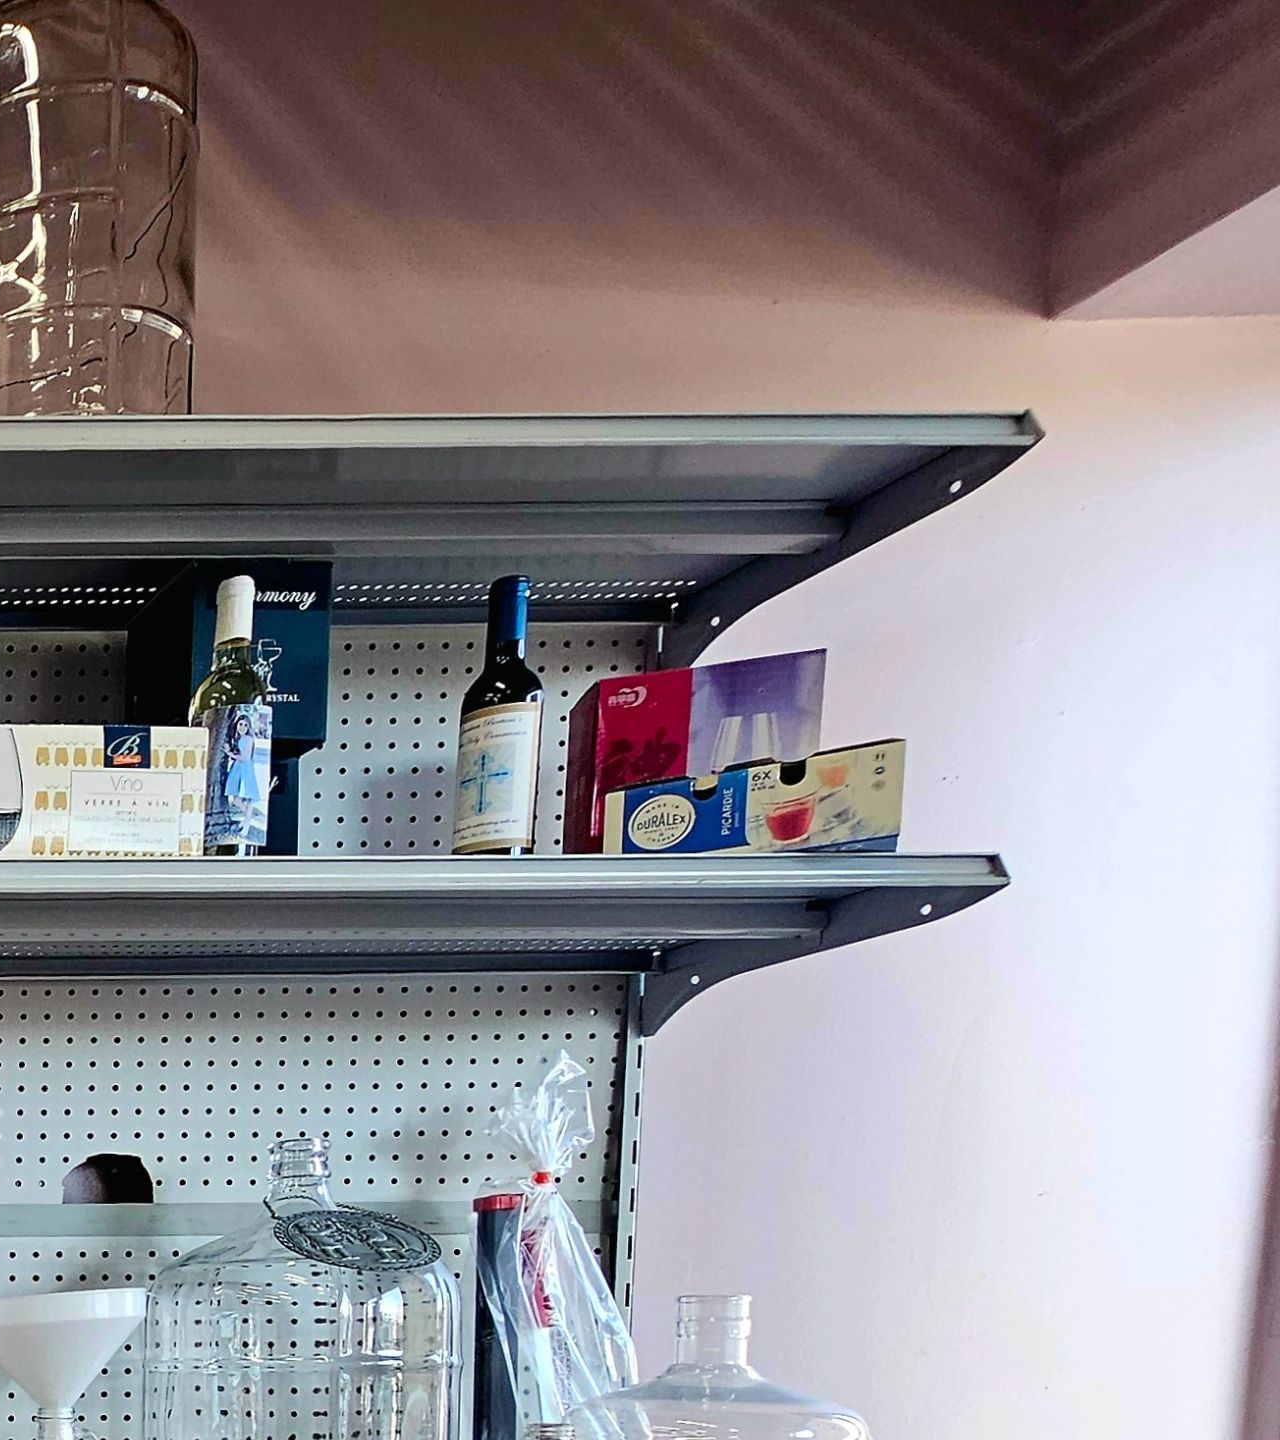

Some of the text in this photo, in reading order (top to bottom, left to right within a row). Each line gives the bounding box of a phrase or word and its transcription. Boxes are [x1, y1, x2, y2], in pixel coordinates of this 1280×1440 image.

[255, 590, 317, 611] rmony
[110, 775, 143, 791] Vino
[752, 770, 772, 782] 6X
[721, 787, 733, 836] PICARDIE
[637, 812, 687, 831] DURALEX
